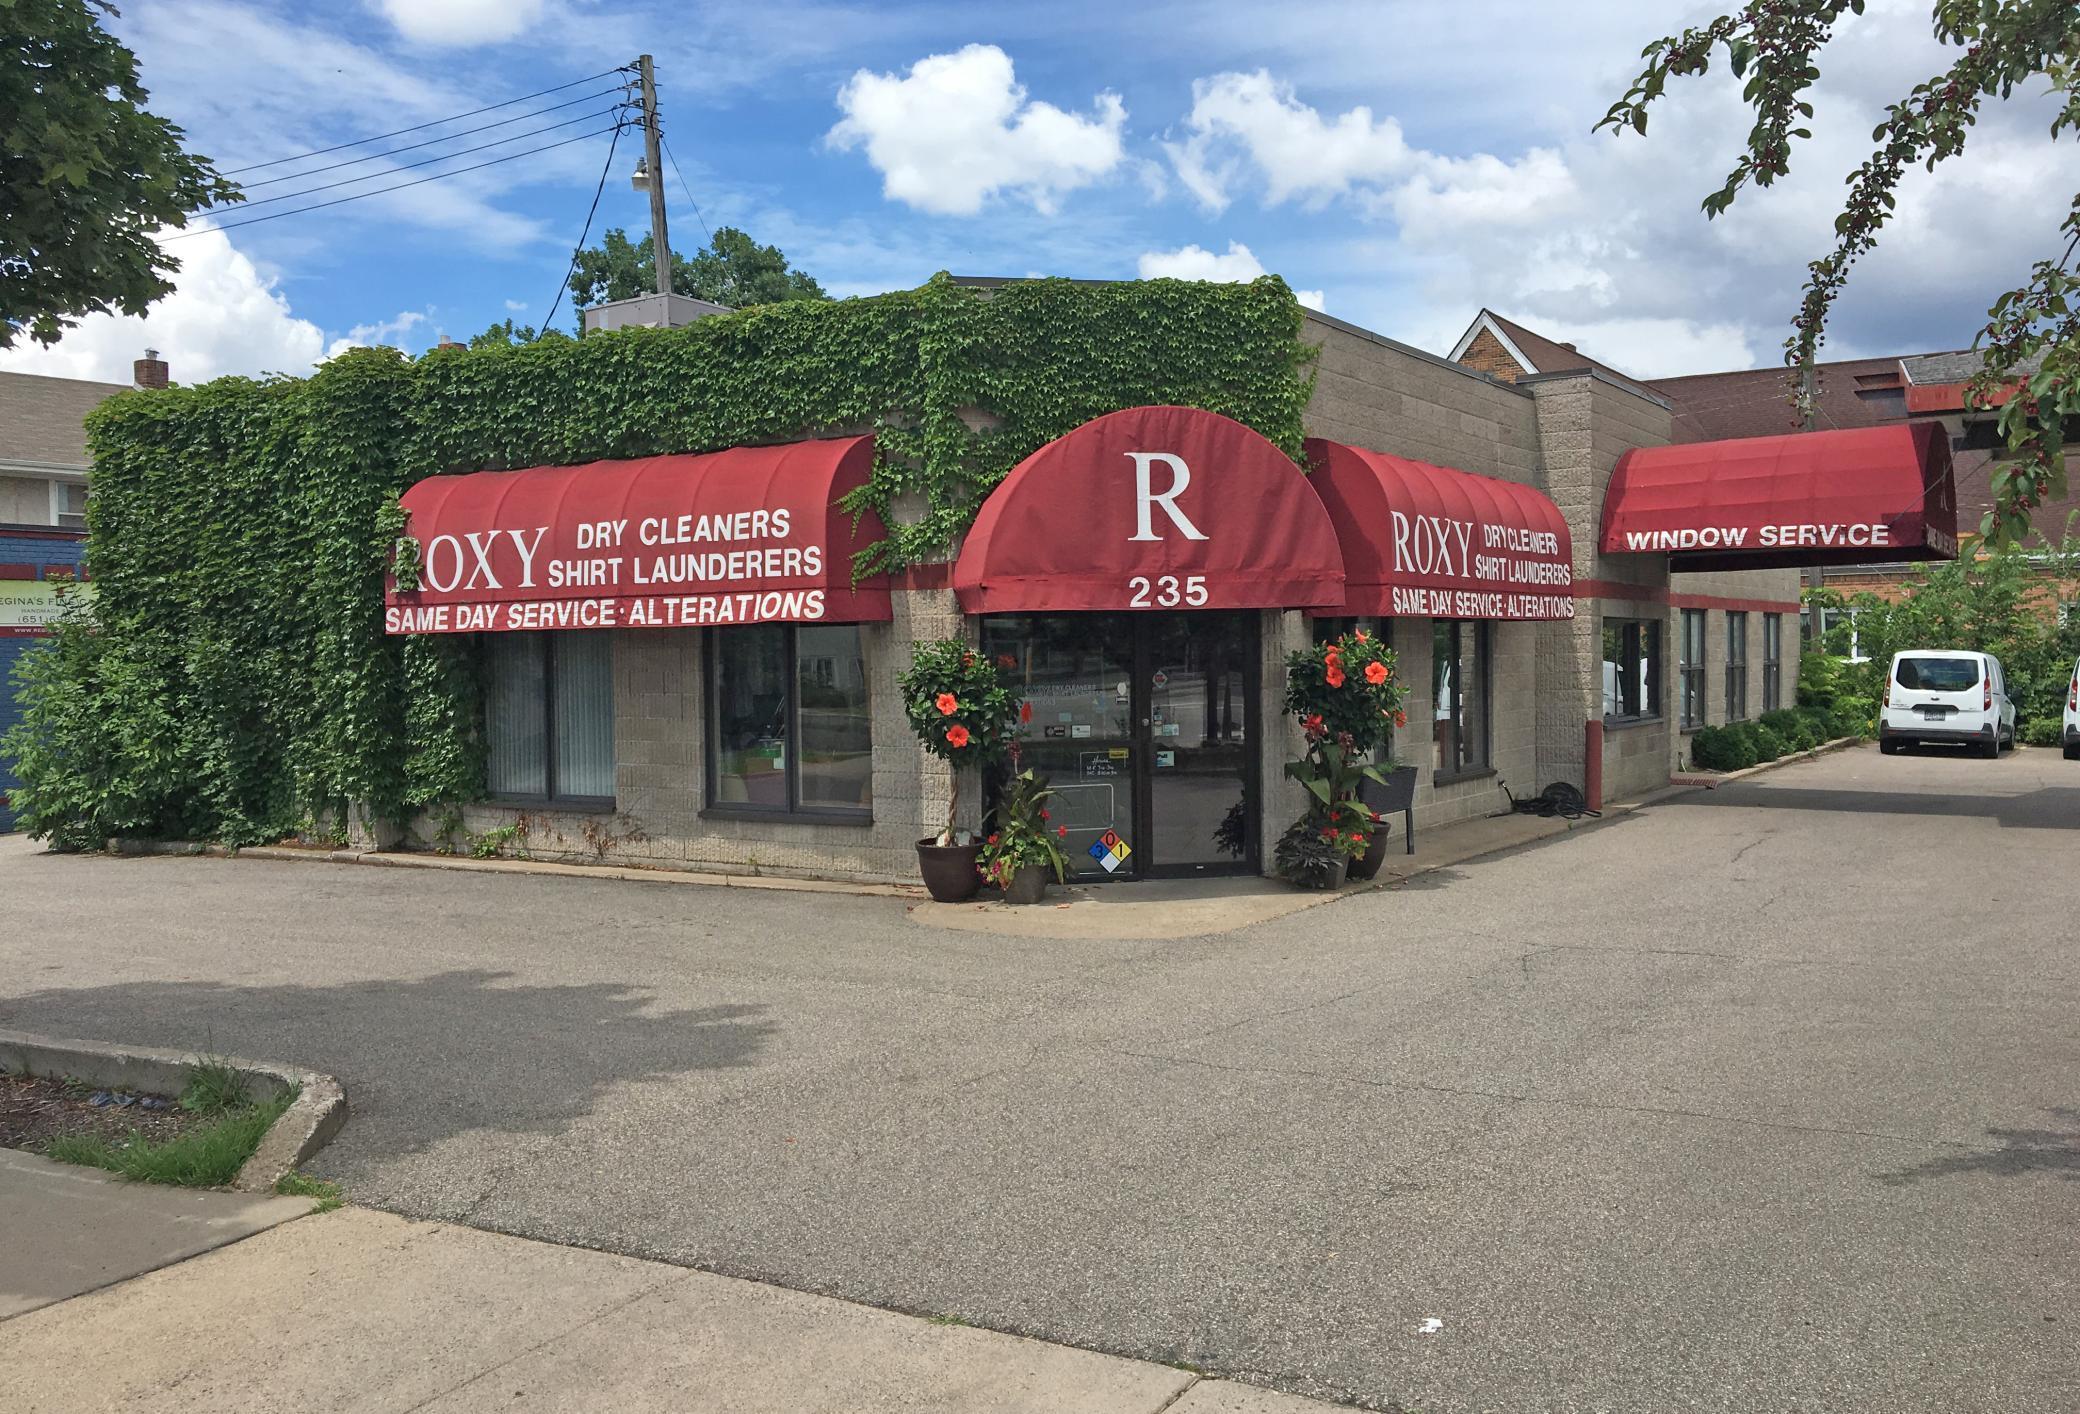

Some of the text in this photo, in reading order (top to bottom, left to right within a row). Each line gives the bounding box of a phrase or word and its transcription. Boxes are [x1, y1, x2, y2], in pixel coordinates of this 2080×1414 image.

[1124, 452, 1210, 541] R
[577, 508, 790, 549] DRY CLEANERS
[1390, 510, 1474, 578] ROXY
[1483, 524, 1558, 556] DRY CLEANERS
[1626, 523, 1890, 550] WINDOW SERVICE
[548, 546, 822, 588] SHIRT LAUNDERERS
[1475, 553, 1571, 586] SHIRT LAUNDERERS
[1128, 575, 1209, 608] 235
[1392, 586, 1575, 618] SAME DAY SERVICE ALTERATIONS
[385, 590, 825, 633] SAME DAY SERVICE ALTERATIONS
[1095, 843, 1123, 859] 3 1
[1105, 832, 1115, 846] 0
